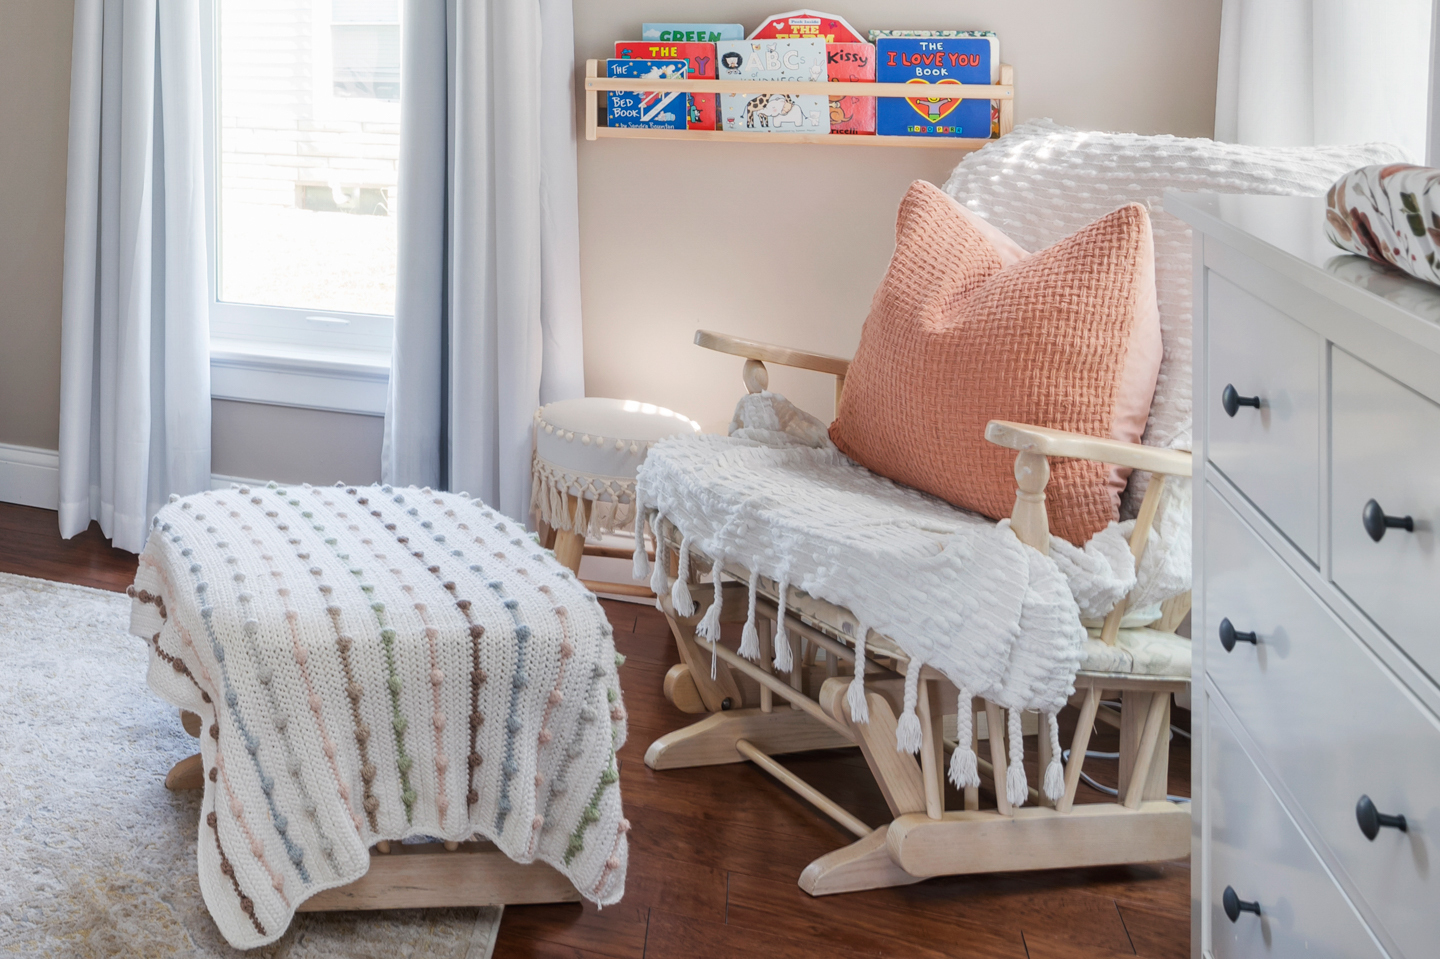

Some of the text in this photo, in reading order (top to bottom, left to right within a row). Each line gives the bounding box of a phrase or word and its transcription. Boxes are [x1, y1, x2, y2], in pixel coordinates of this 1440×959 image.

[791, 25, 819, 34] THE
[660, 30, 721, 42] GREEN
[920, 42, 943, 50] THE
[649, 46, 678, 57] THE
[828, 49, 868, 67] Kissy
[887, 51, 980, 67] I LOVE YOU
[611, 63, 629, 75] THE
[915, 67, 949, 76] BOOK
[612, 97, 633, 107] BED
[612, 108, 640, 118] BOOK
